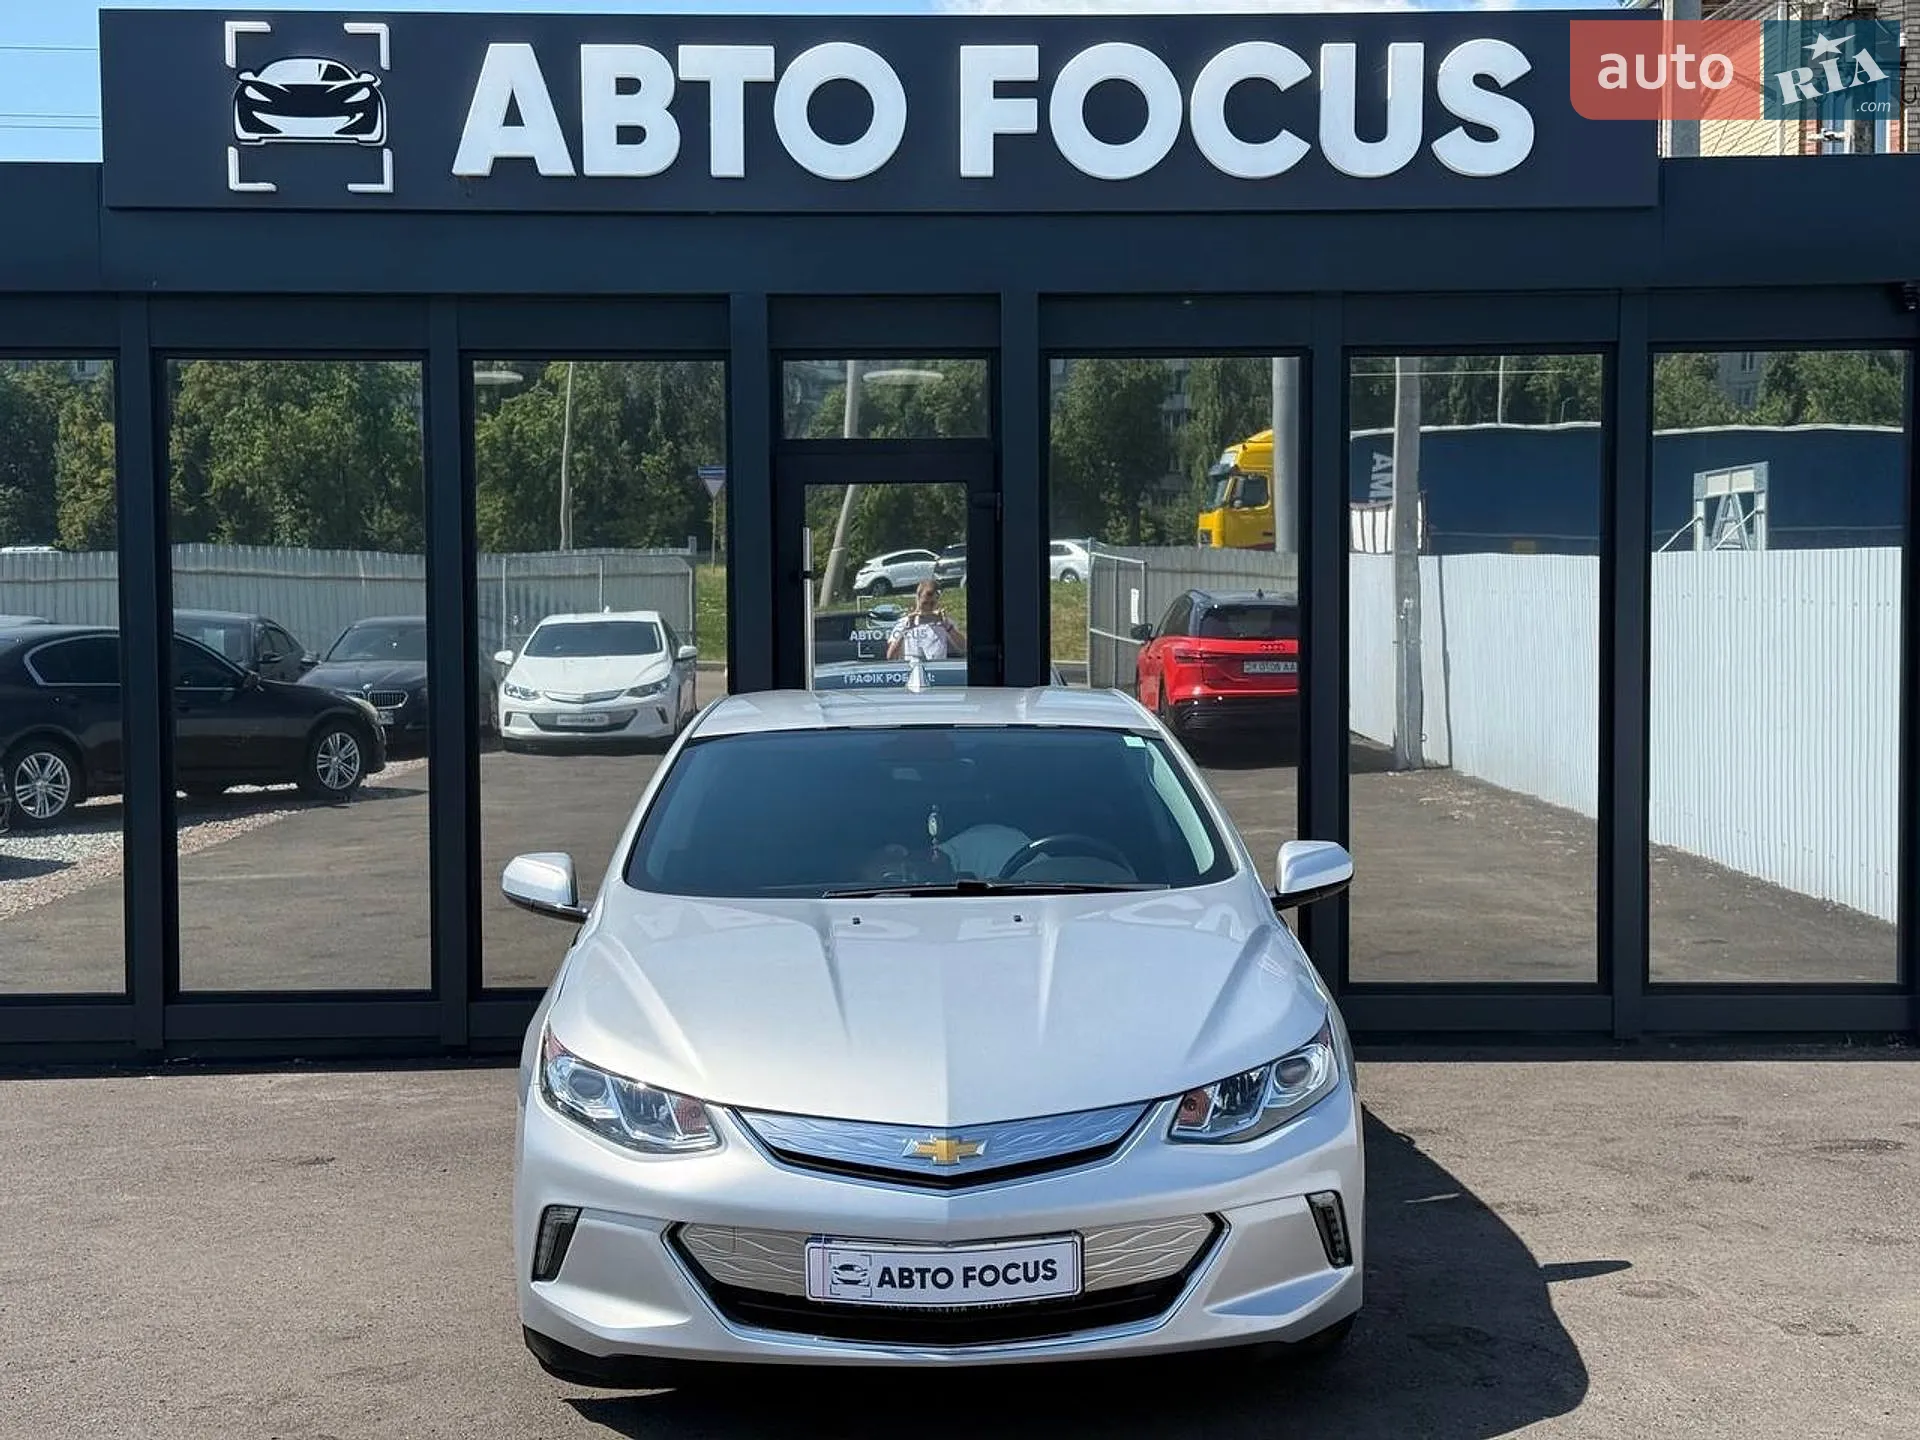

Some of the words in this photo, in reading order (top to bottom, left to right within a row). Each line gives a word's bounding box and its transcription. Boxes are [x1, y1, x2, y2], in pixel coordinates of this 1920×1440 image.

[452, 42, 907, 180] АВТО
[959, 38, 1536, 180] FOCUS
[850, 630, 884, 641] АВТО
[877, 1266, 954, 1290] АВТО
[962, 1258, 1058, 1288] FOCUS
